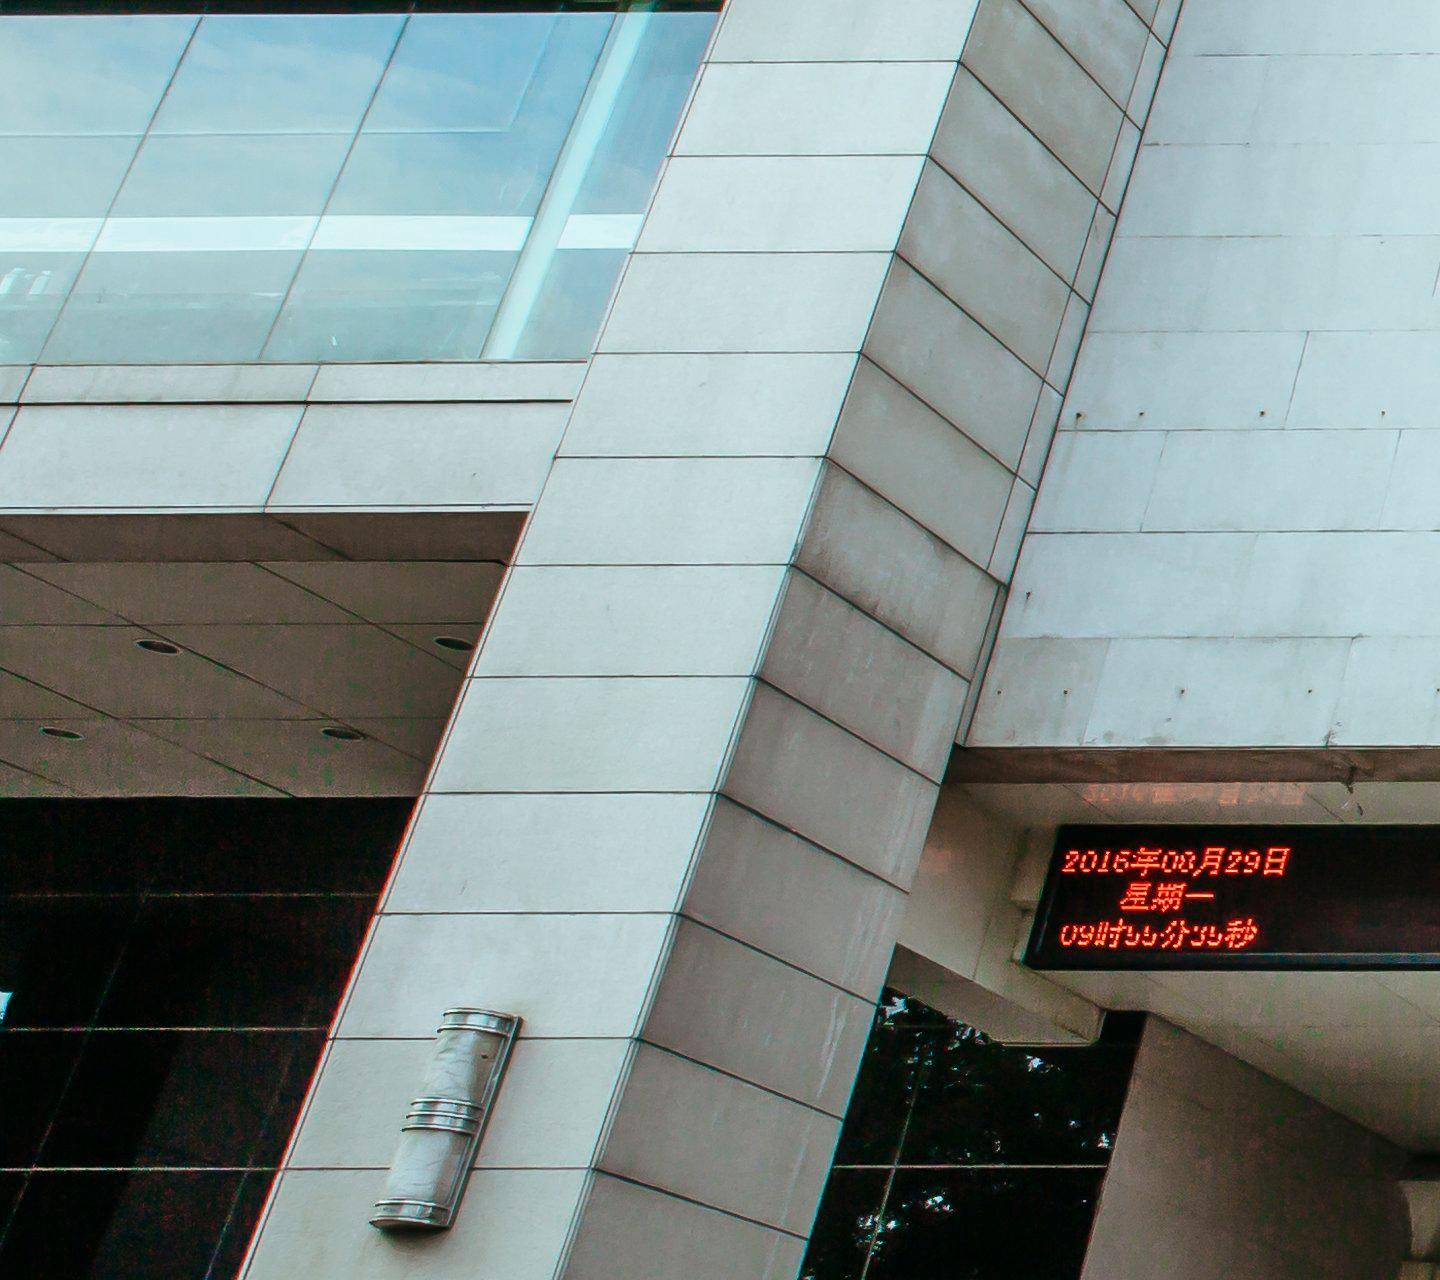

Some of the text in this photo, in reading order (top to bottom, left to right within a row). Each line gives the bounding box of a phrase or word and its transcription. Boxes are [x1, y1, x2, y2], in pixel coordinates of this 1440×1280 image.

[1061, 846, 1291, 877] 2016年08月29日
[1119, 881, 1215, 913] 星期一
